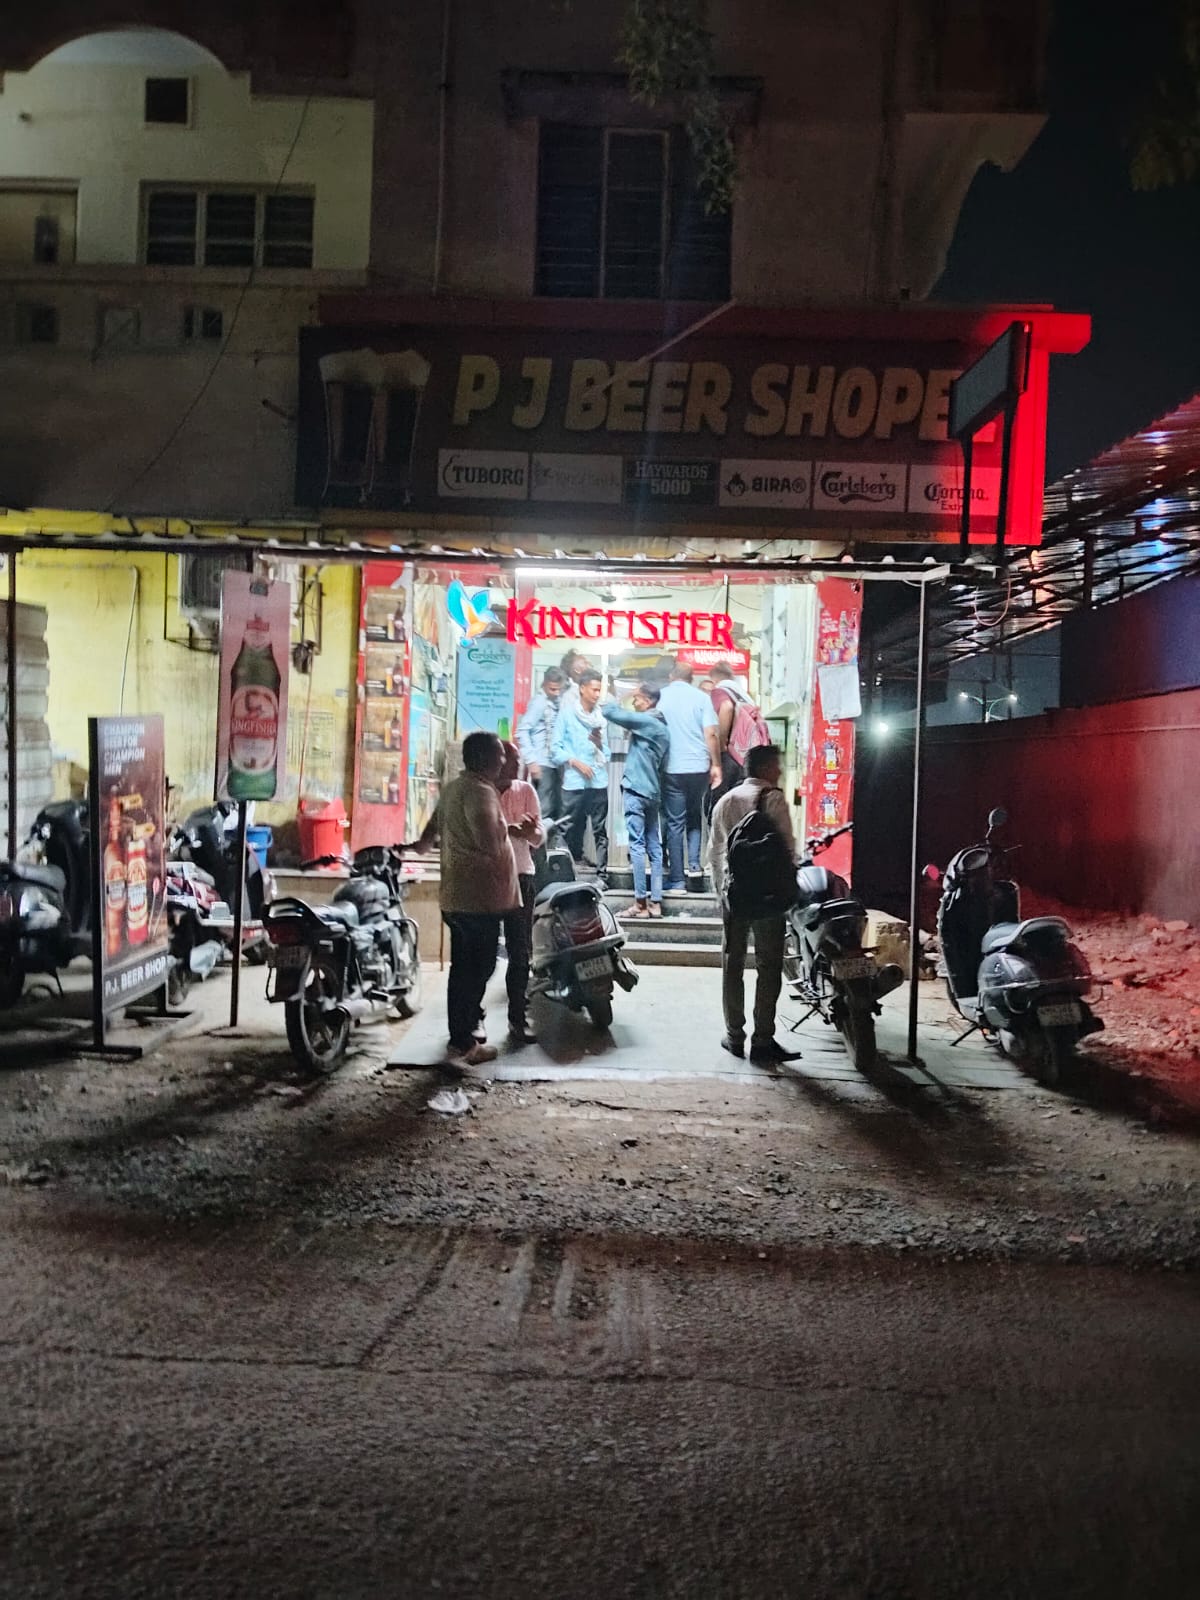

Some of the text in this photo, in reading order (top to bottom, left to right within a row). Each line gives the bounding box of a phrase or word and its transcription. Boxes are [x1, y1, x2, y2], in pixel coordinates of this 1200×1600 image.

[453, 354, 501, 426] P
[511, 356, 553, 430] J
[564, 358, 732, 434] BEER
[452, 465, 524, 487] TUBORG
[651, 479, 691, 497] 5000
[820, 471, 896, 501] Carlsberg
[505, 596, 734, 650] KINGFISHER
